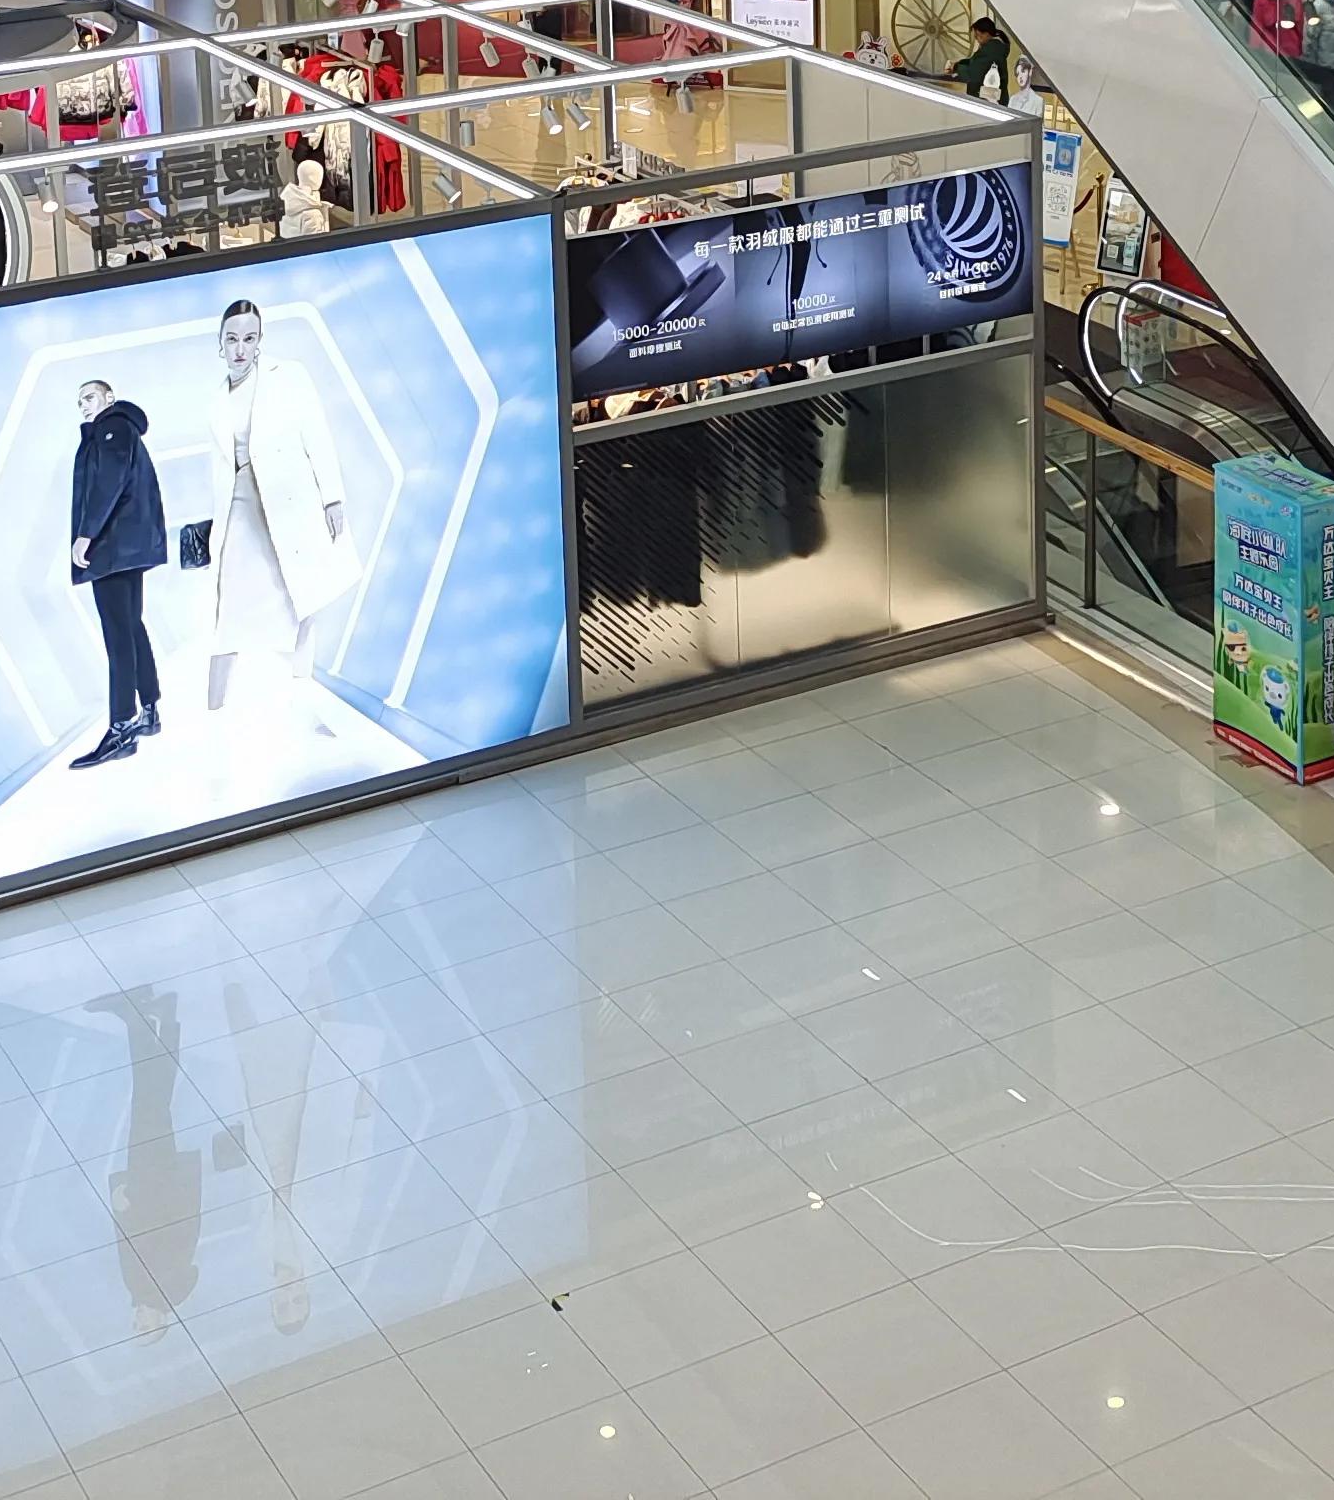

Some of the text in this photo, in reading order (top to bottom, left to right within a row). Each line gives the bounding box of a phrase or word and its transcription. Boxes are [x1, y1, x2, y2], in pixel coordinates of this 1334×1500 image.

[694, 203, 926, 260] 每一款羽绒服都能通过三重测试
[1233, 572, 1284, 612] 万达宝贝王
